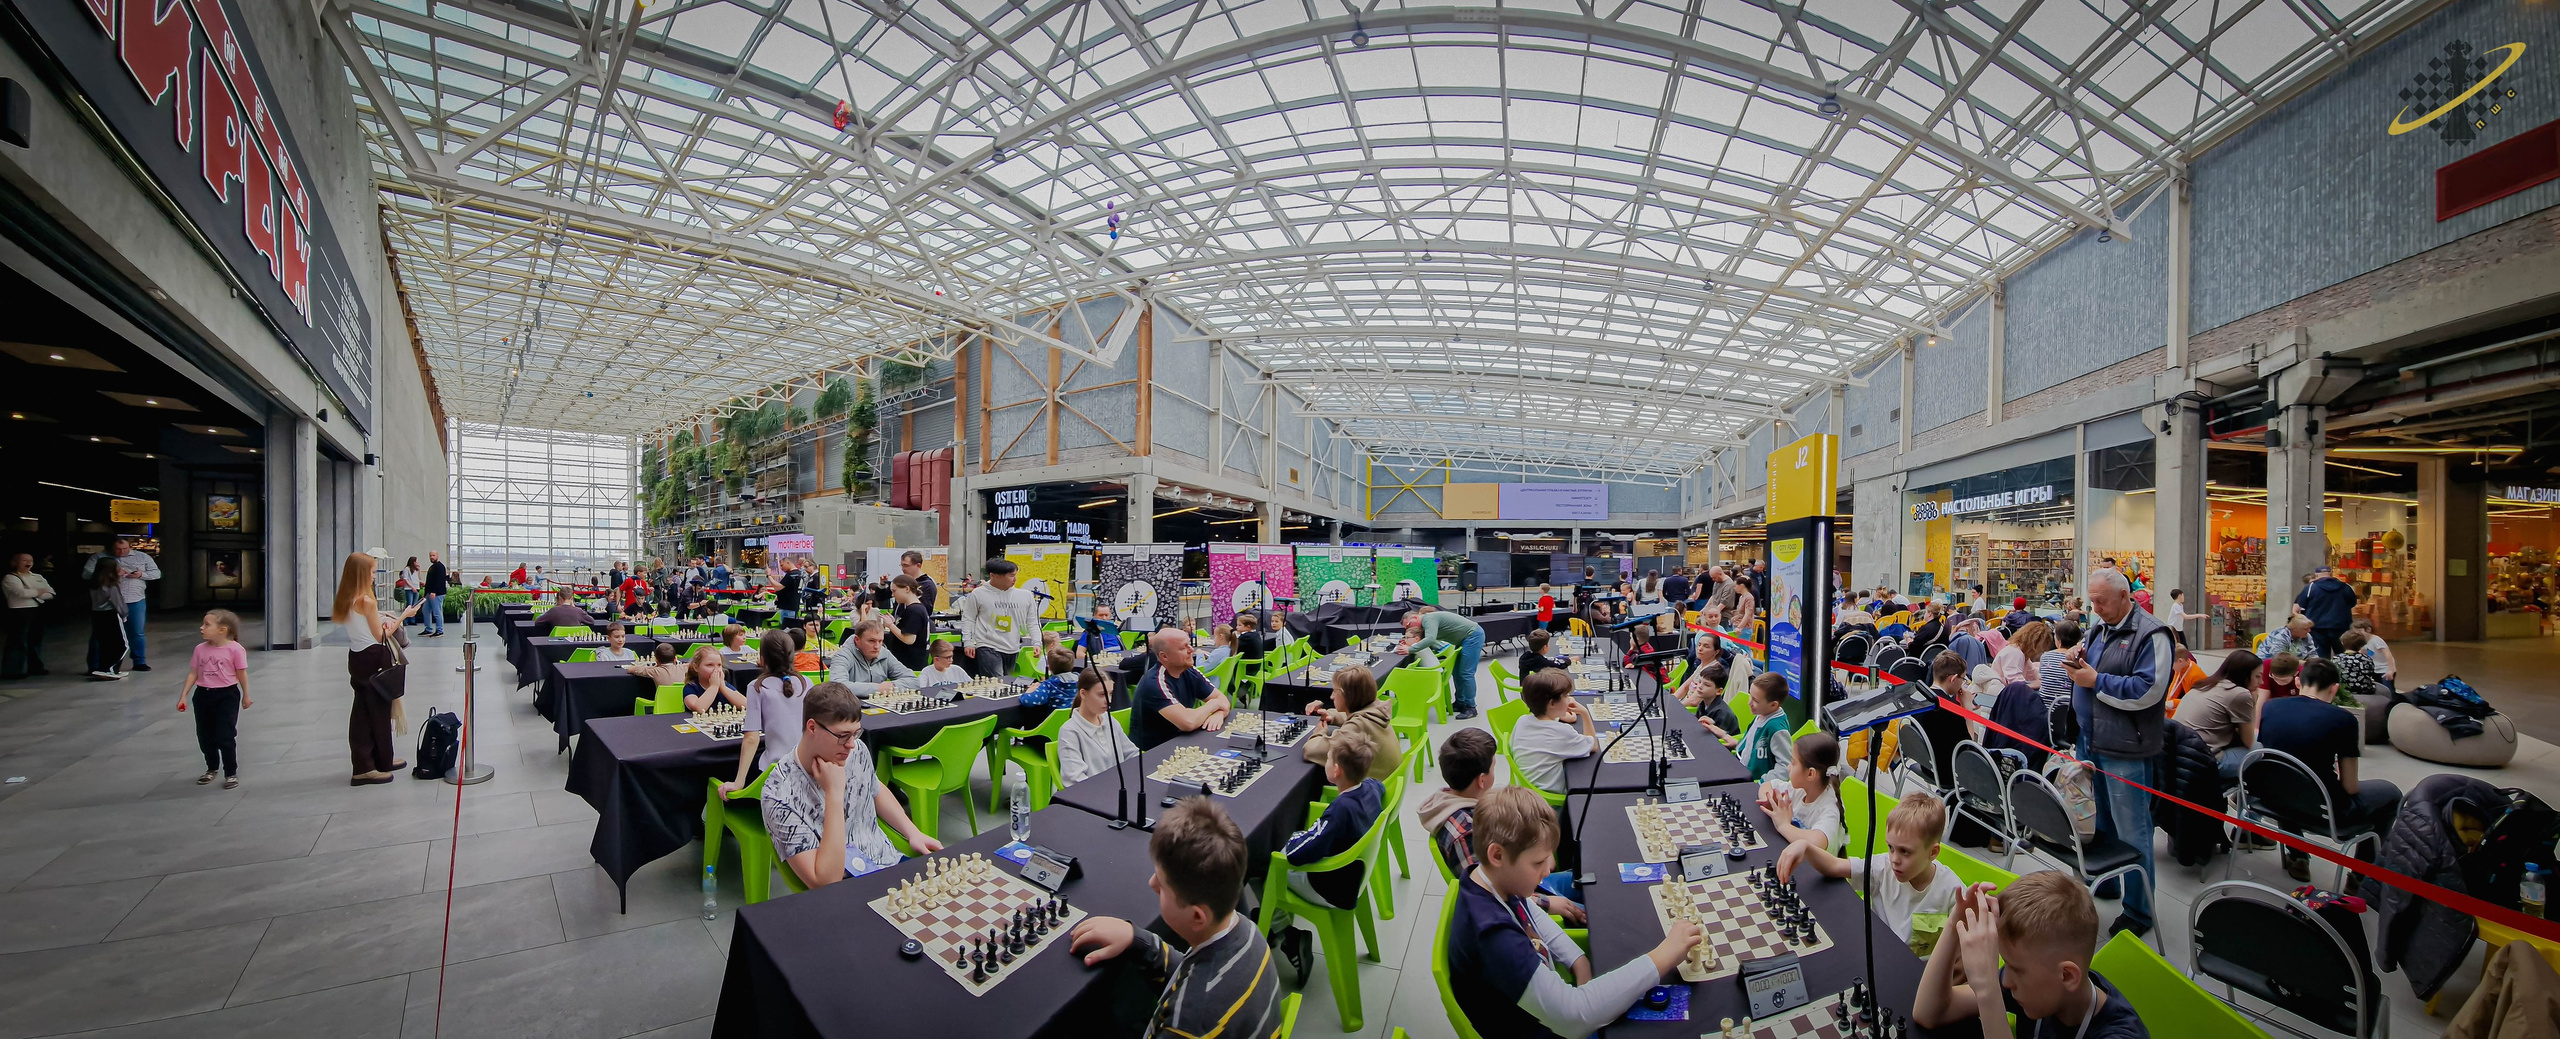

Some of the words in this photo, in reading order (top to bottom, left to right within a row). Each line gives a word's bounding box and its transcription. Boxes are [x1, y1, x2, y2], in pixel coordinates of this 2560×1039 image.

[82, 0, 313, 329] ИРАЖ
[1795, 445, 1808, 469] J2
[1941, 491, 2012, 514] НАСТОЛЬНЫЕ
[2014, 485, 2053, 505] ИГРЫ
[2507, 485, 2560, 503] МАГАЗИН
[998, 504, 1030, 519] MARIO
[1067, 522, 1090, 535] MARIO
[1771, 631, 1779, 642] Все
[1780, 635, 1800, 648] границы
